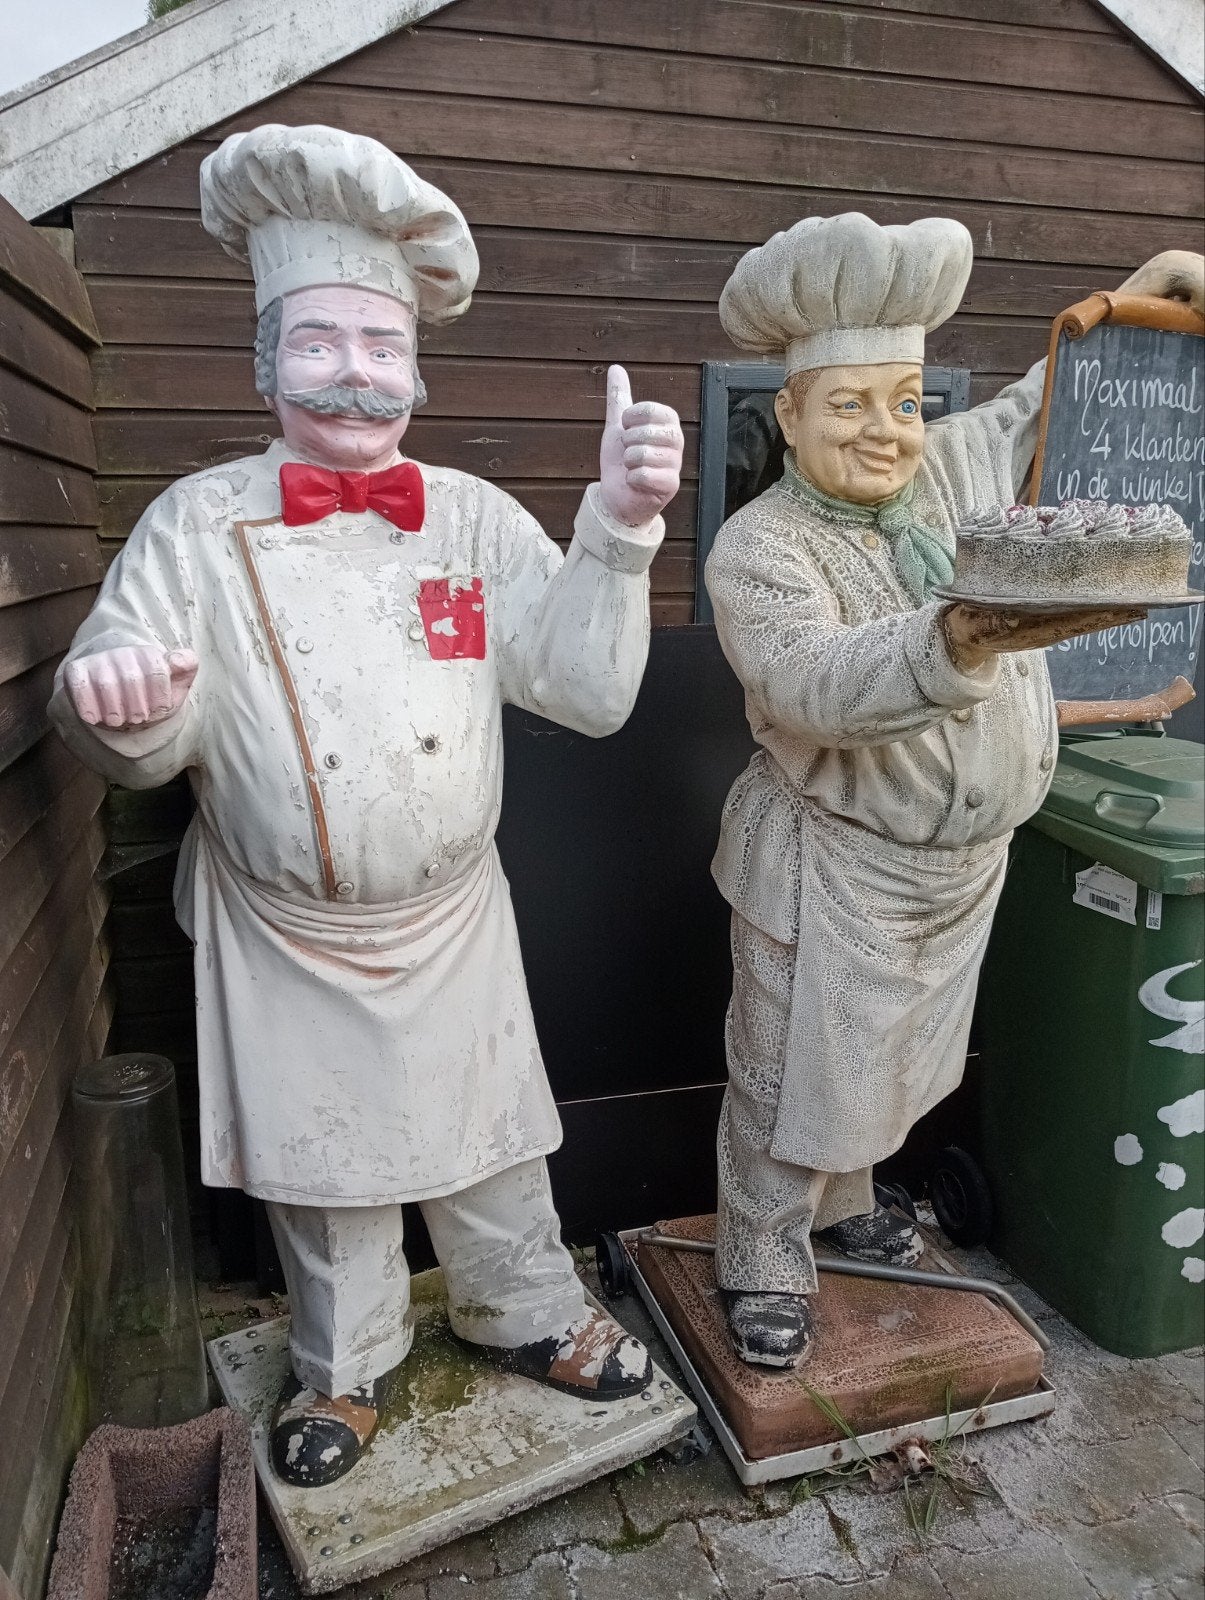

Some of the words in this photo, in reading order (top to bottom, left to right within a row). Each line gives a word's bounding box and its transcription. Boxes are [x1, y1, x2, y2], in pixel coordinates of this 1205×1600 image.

[1074, 358, 1202, 436] Maximaal
[1089, 418, 1112, 461] 4
[1124, 421, 1205, 466] klanten
[1056, 453, 1081, 501] in
[1087, 469, 1112, 499] de
